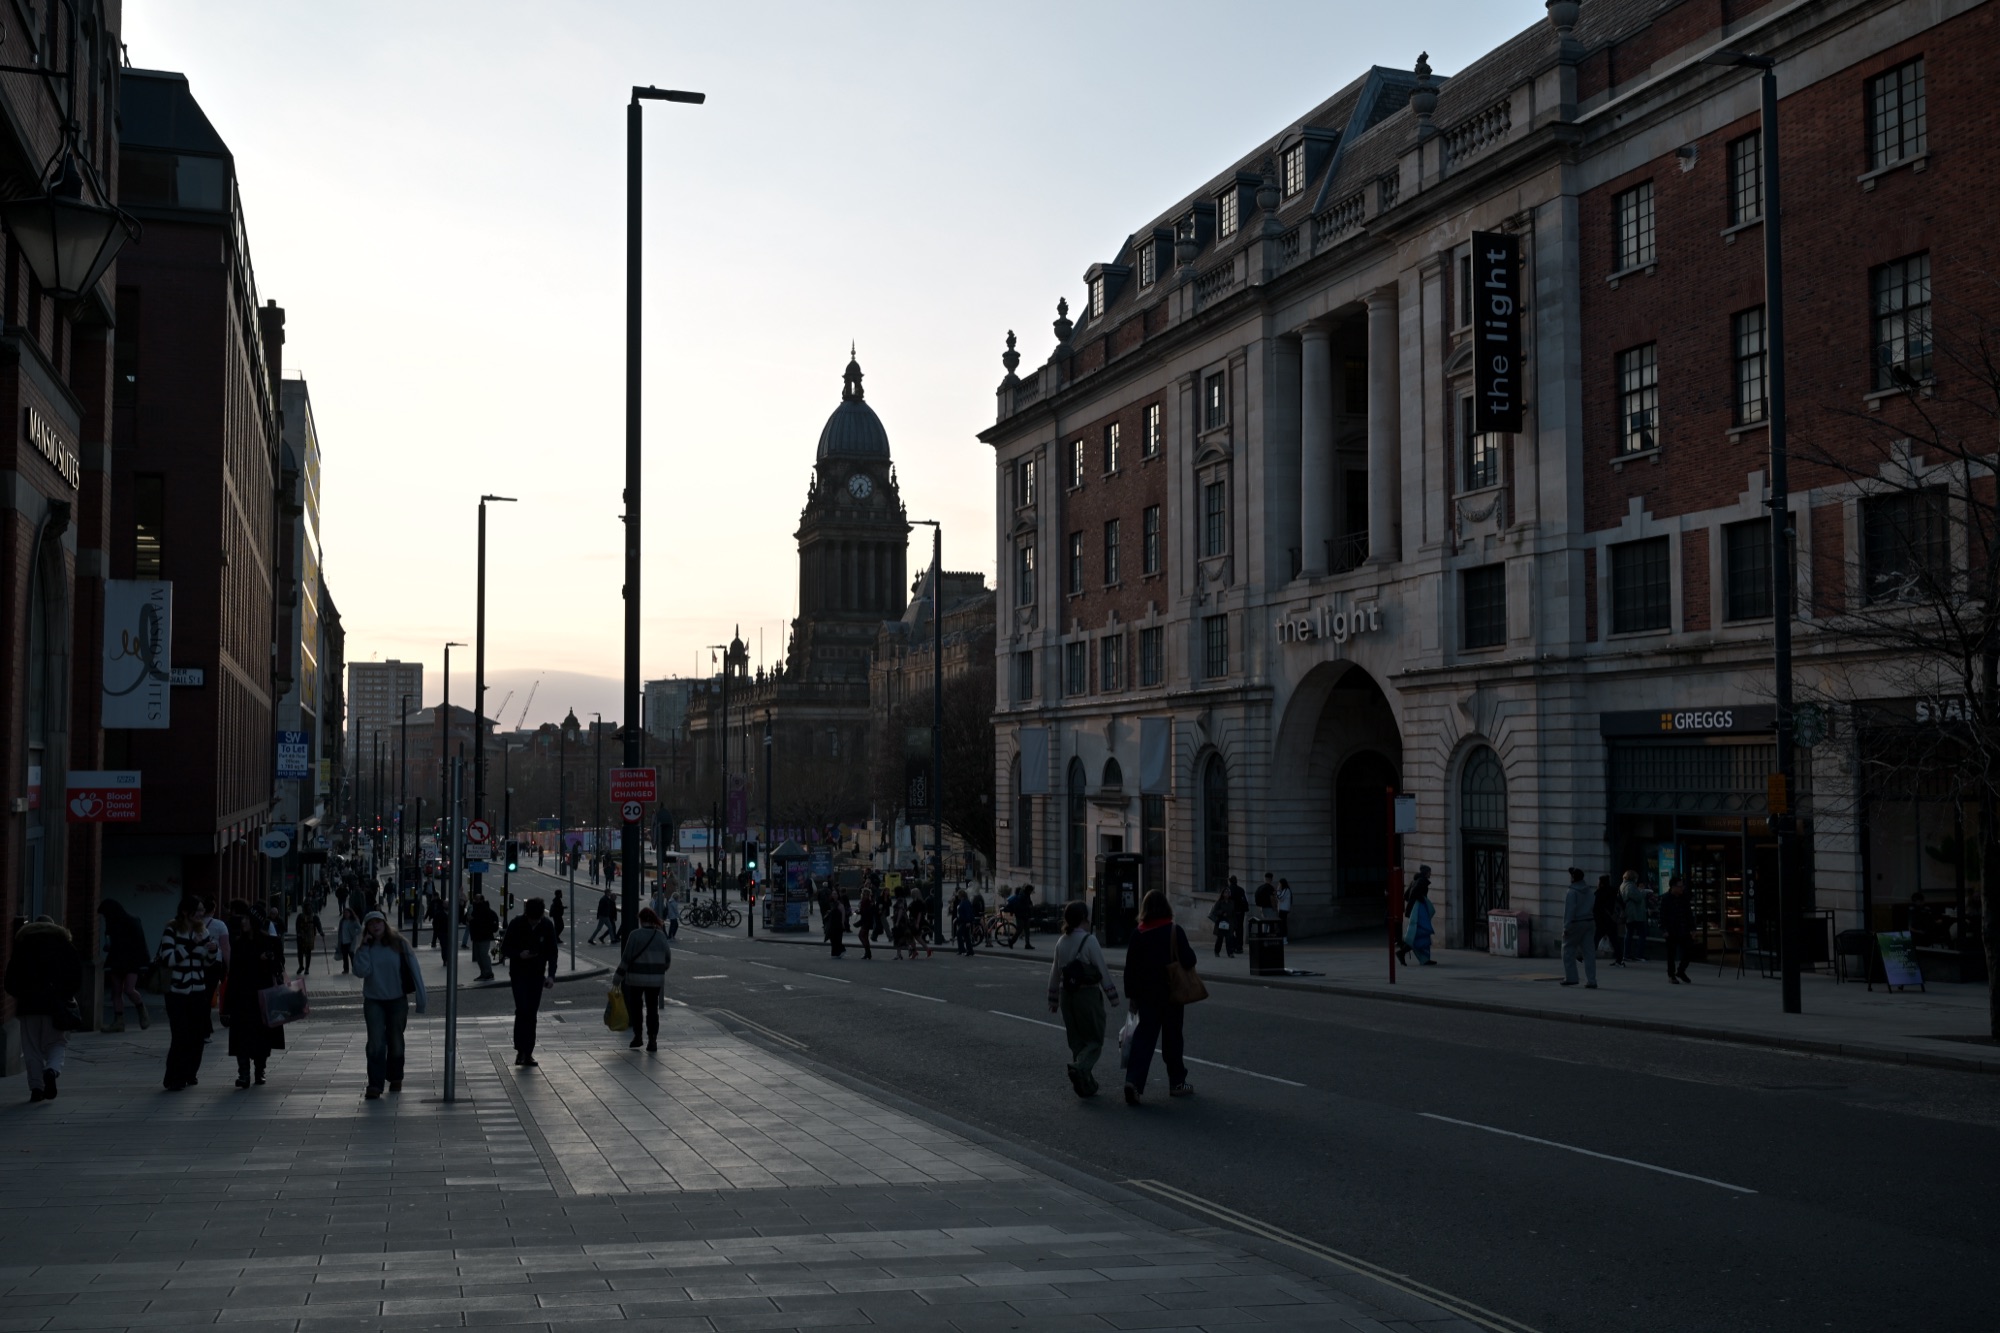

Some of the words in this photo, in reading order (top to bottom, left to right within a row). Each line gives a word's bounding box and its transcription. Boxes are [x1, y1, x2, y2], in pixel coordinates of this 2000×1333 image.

[1485, 249, 1512, 341] light
[1487, 355, 1509, 414] the
[30, 406, 58, 467] MANSIO
[58, 441, 79, 491] SUITES
[150, 587, 163, 655] MANSIO
[1274, 612, 1309, 645] the
[1316, 600, 1379, 645] light
[148, 660, 163, 721] SUITES
[1674, 710, 1733, 730] GREGGS
[281, 745, 291, 753] To
[293, 745, 305, 754] Let
[285, 731, 301, 743] SW
[106, 792, 132, 800] Blood
[106, 801, 133, 809] Donor
[614, 790, 653, 798] CHANGED
[916, 776, 924, 807] MOON
[624, 805, 641, 815] 20
[1504, 922, 1517, 950] UP
